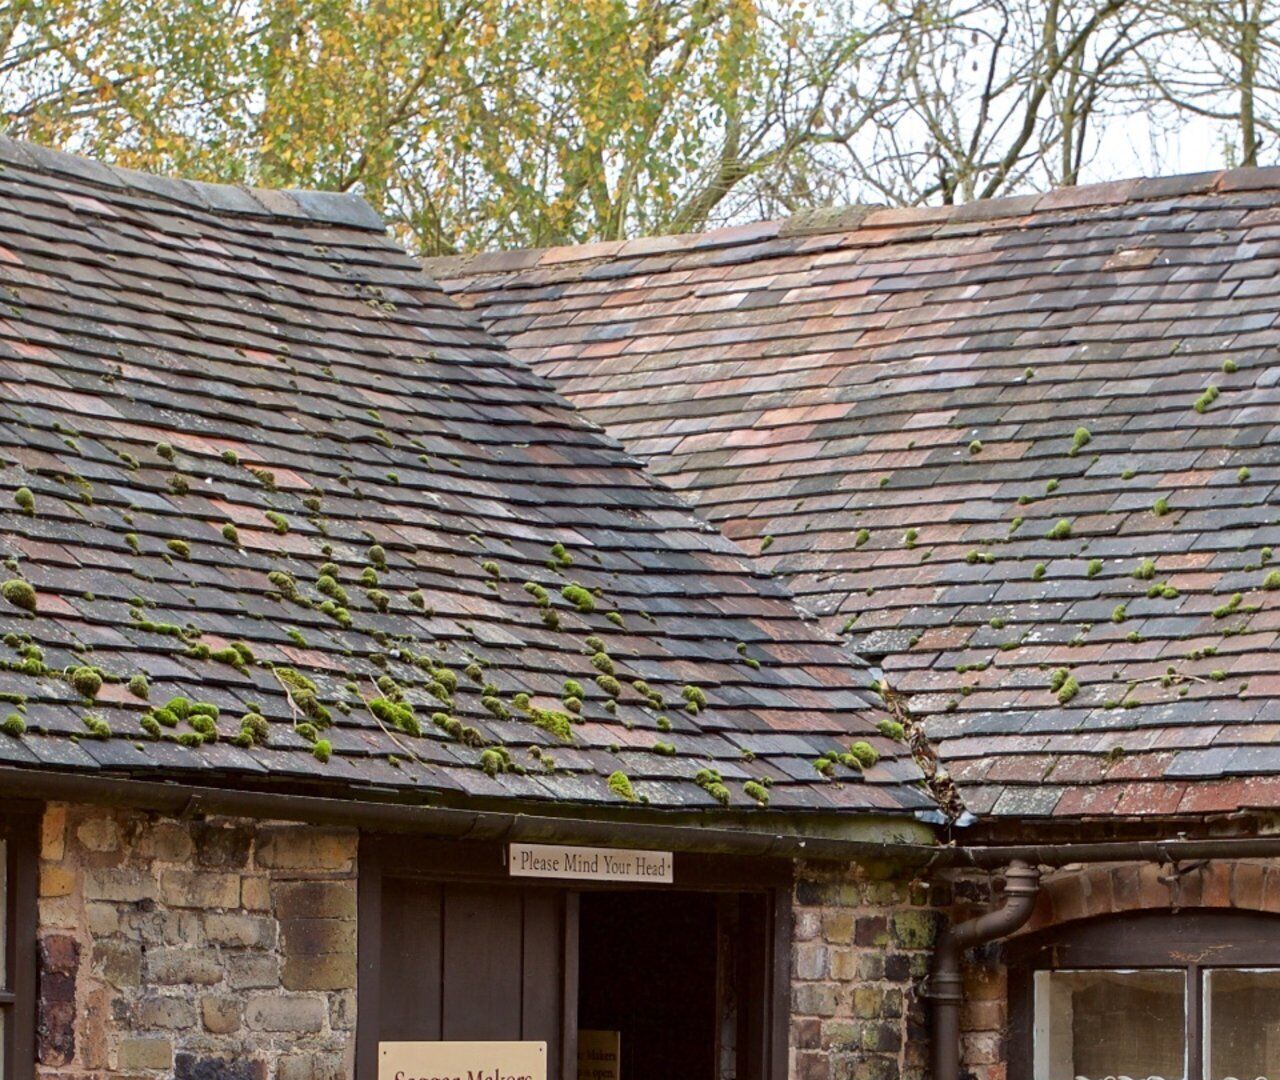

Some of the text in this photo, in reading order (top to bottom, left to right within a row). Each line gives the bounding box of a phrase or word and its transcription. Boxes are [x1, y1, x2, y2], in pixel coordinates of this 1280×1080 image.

[521, 851, 665, 876] Please Mind Your Head
